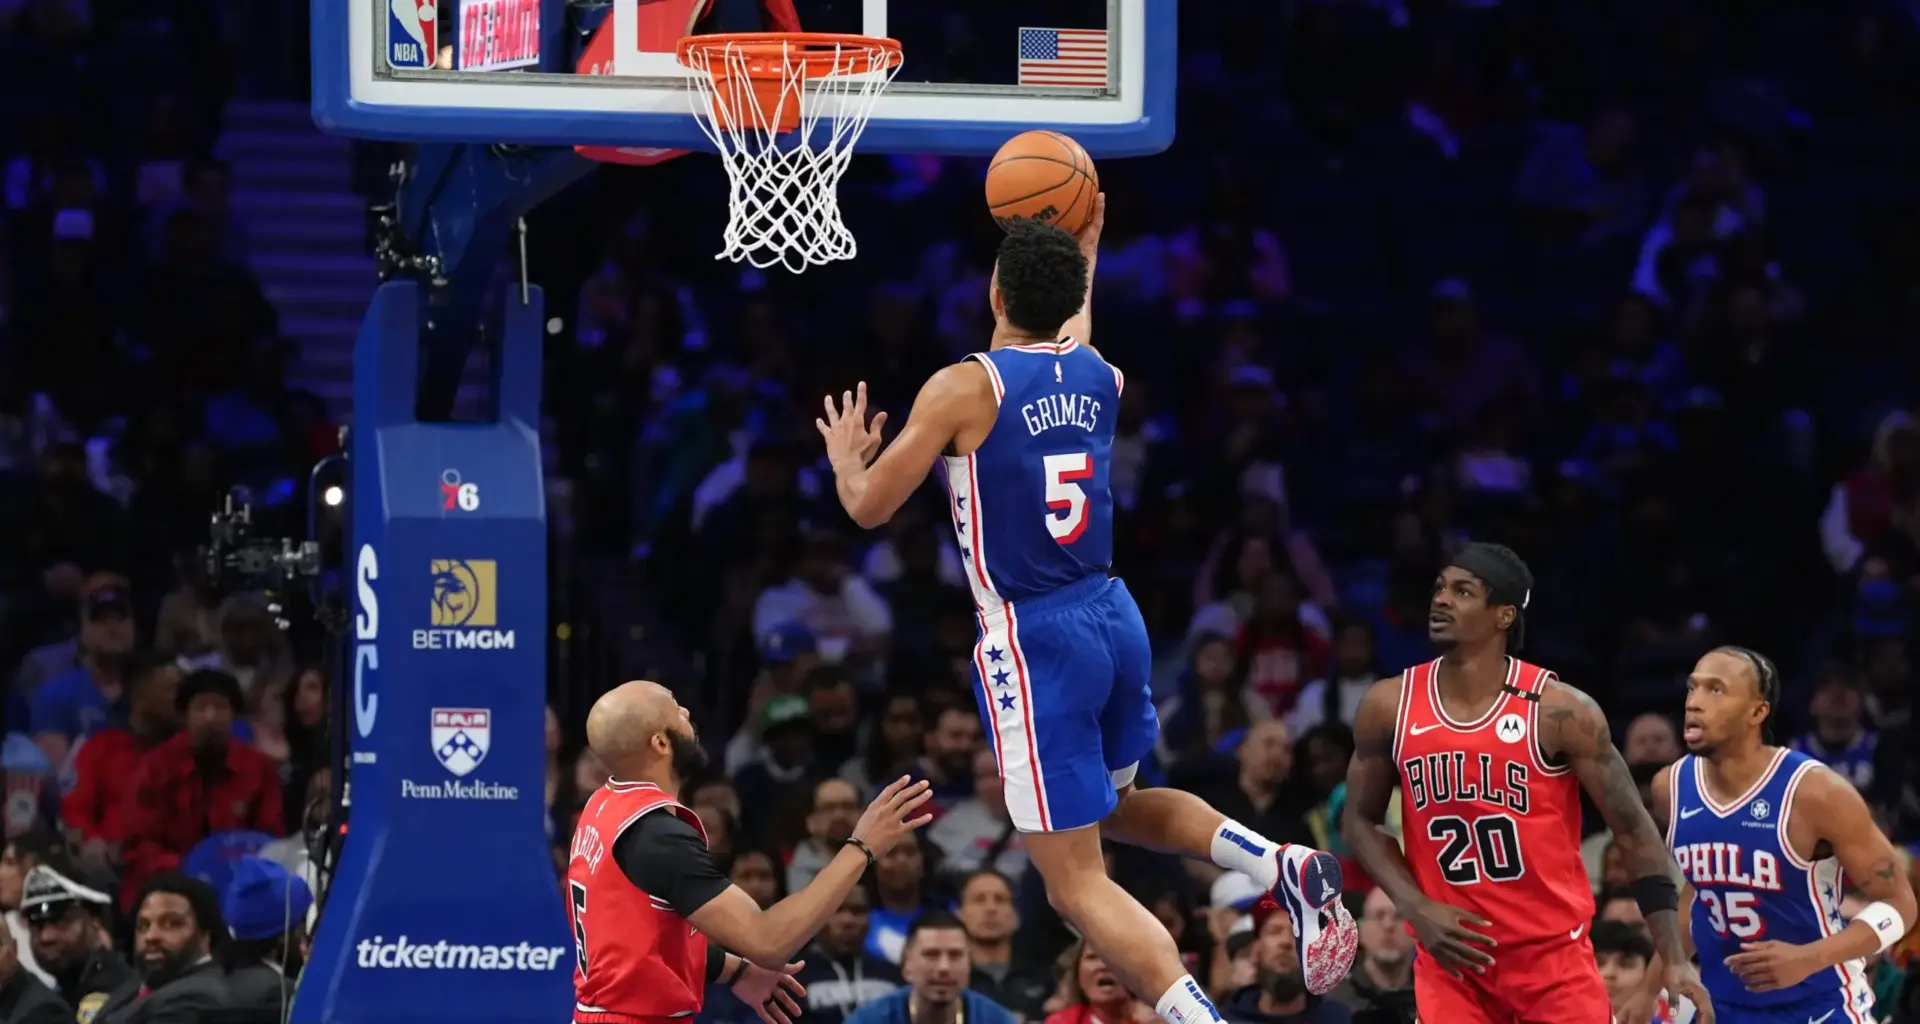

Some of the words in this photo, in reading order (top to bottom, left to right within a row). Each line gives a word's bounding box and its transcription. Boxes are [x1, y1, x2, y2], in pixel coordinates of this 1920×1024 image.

[394, 43, 418, 62] NBA
[1021, 393, 1101, 436] GRIMES
[441, 483, 480, 512] 76
[1043, 453, 1093, 545] 5
[412, 629, 515, 650] BETMGM
[401, 779, 442, 799] Penn
[443, 780, 519, 800] Medicine
[1404, 751, 1529, 815] BULLS
[1427, 813, 1525, 885] 20
[1673, 842, 1784, 892] PHILA
[569, 878, 589, 983] 5
[1700, 889, 1766, 939] 35
[356, 936, 565, 970] ticketmaster
